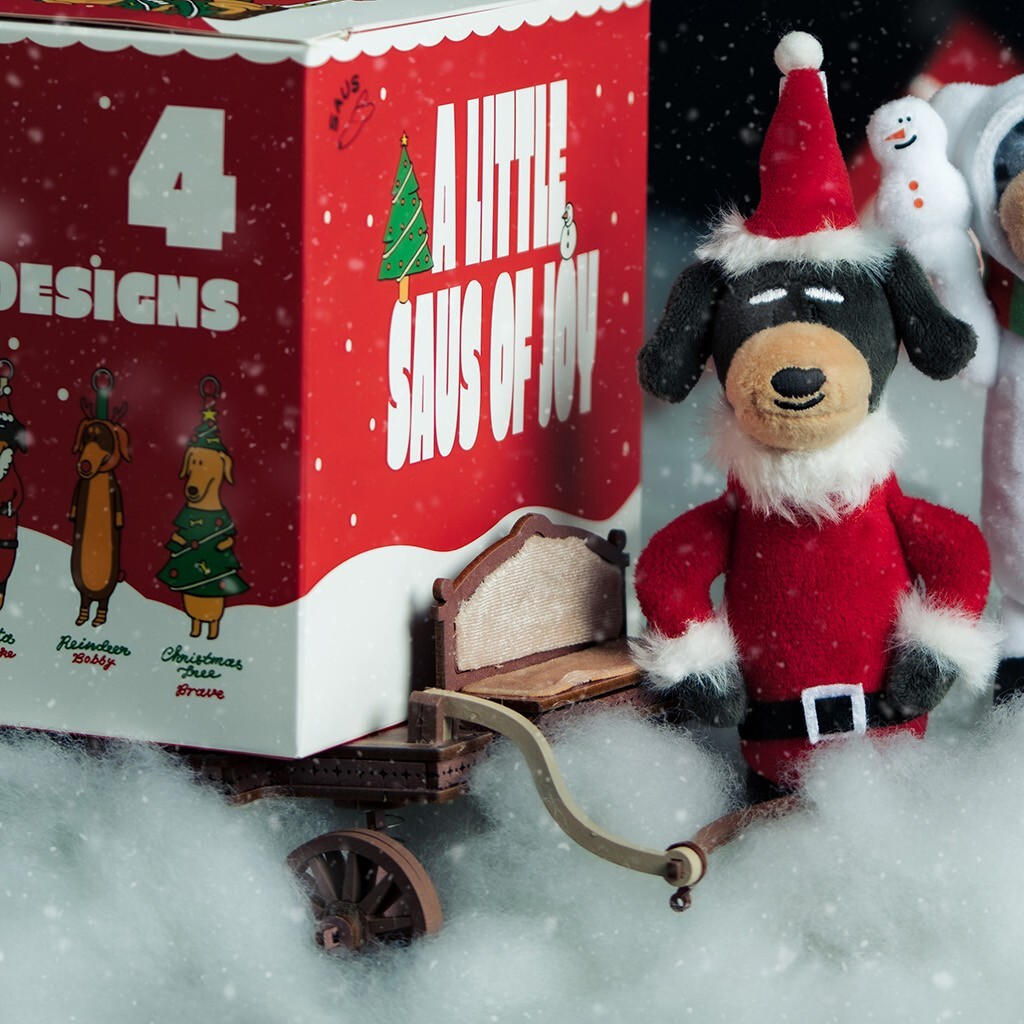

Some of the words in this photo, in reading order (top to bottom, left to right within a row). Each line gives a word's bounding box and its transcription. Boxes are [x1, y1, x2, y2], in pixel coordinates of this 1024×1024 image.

[328, 74, 361, 132] SAUS
[127, 104, 237, 251] 4
[431, 103, 457, 274] A
[464, 79, 568, 266] LITTLE
[386, 279, 482, 471] SAUS
[489, 267, 534, 442] OF
[538, 248, 600, 428] JOY
[56, 634, 131, 657] Reindeer
[72, 653, 116, 671] Bobby
[160, 645, 244, 671] Christmas
[175, 683, 225, 700] Brave
